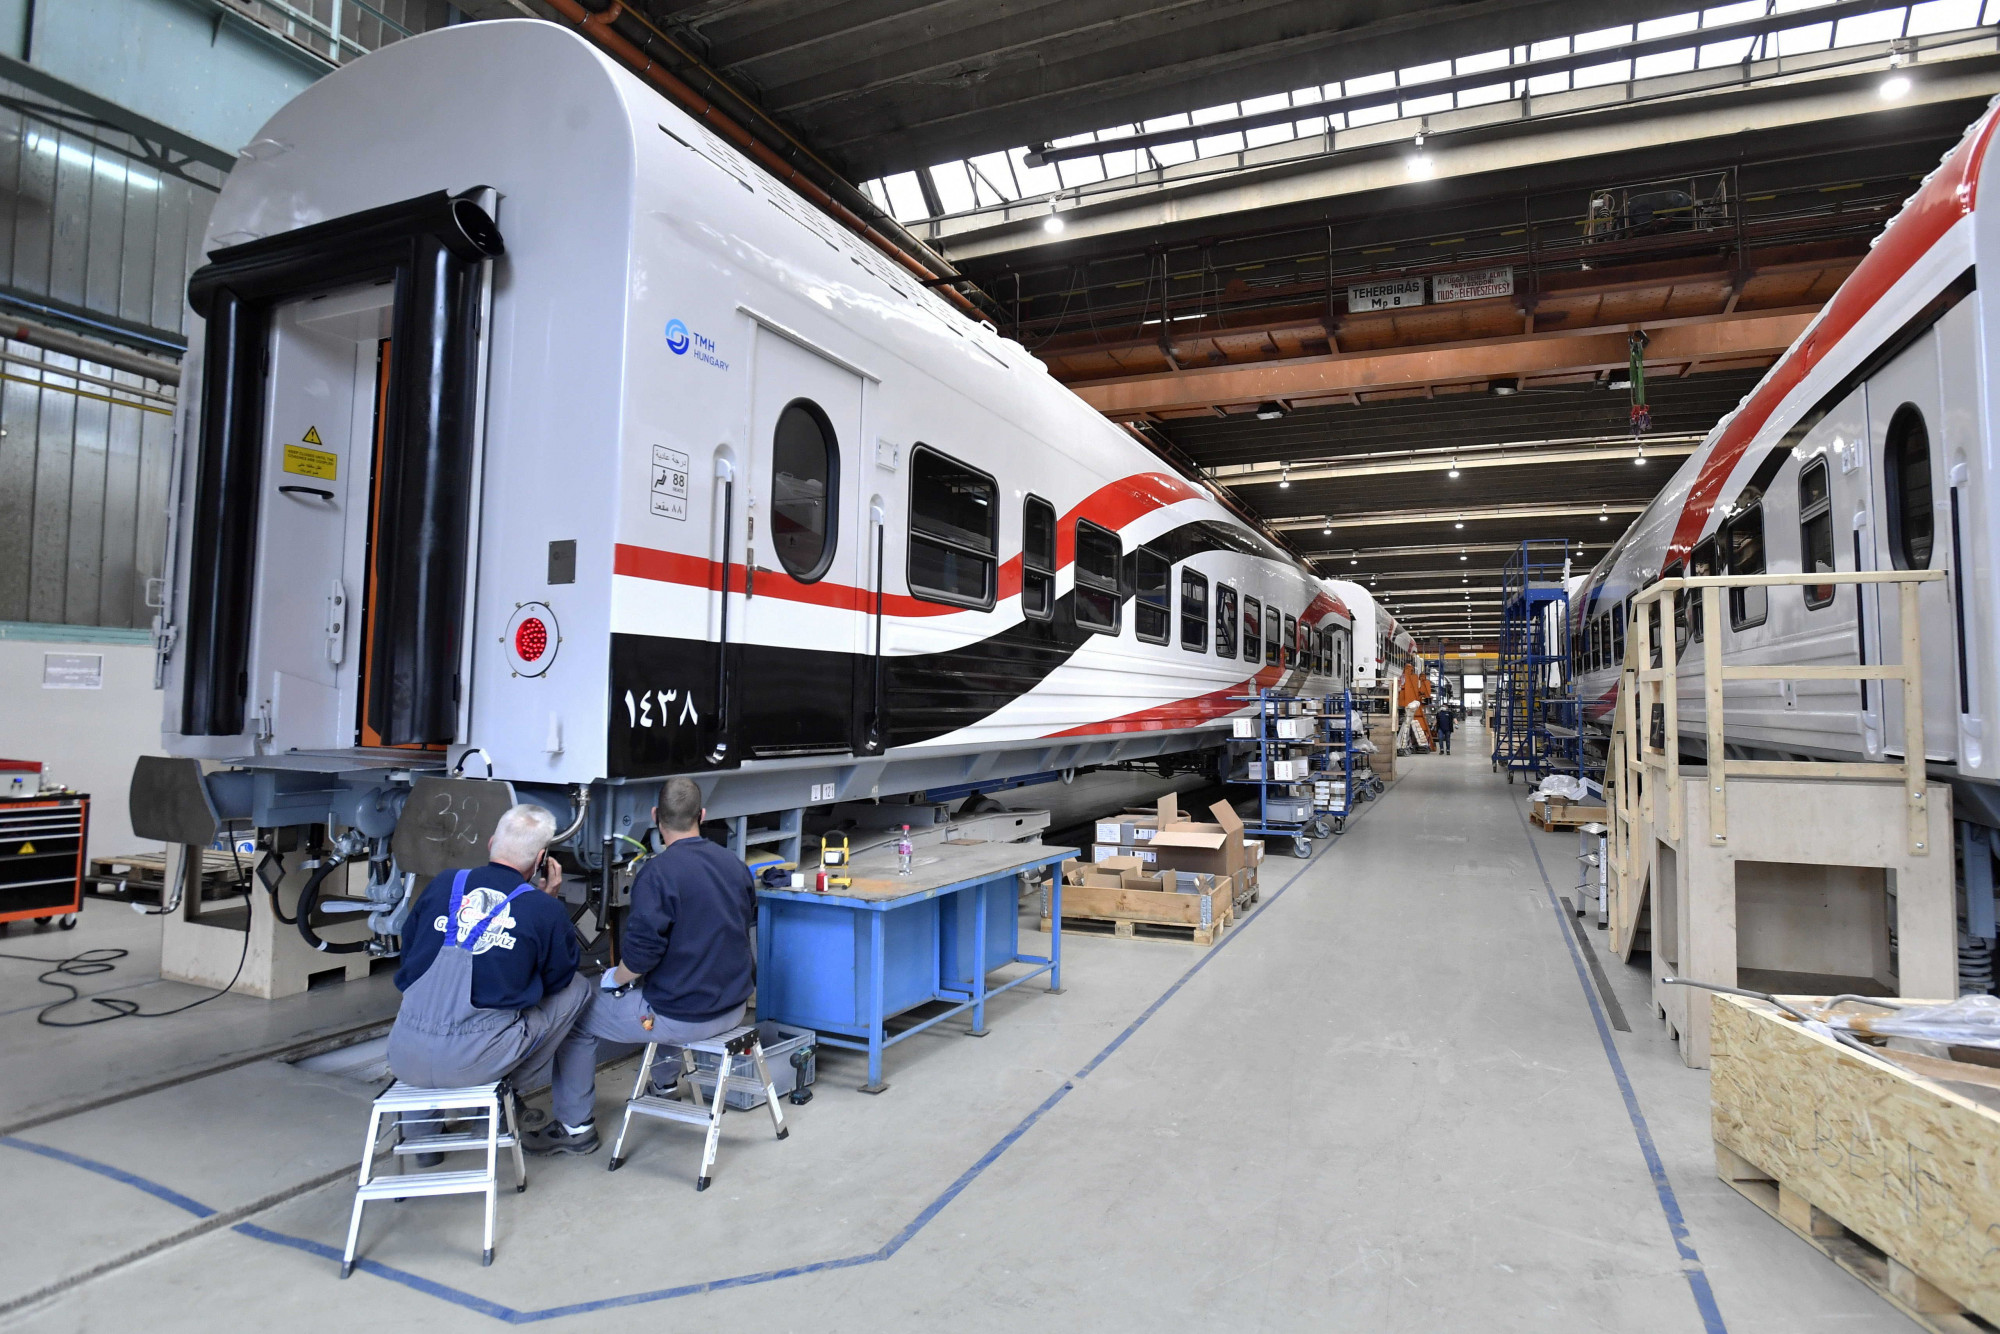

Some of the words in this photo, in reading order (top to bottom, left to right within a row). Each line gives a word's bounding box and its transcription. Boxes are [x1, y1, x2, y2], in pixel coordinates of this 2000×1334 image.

[1371, 298, 1388, 309] Mp
[1393, 296, 1401, 306] 8
[1437, 289, 1453, 300] TILOS
[693, 332, 715, 353] TMH
[693, 349, 730, 372] HUNGARY
[672, 473, 685, 487] 88
[624, 689, 698, 728] ١٤٣٨
